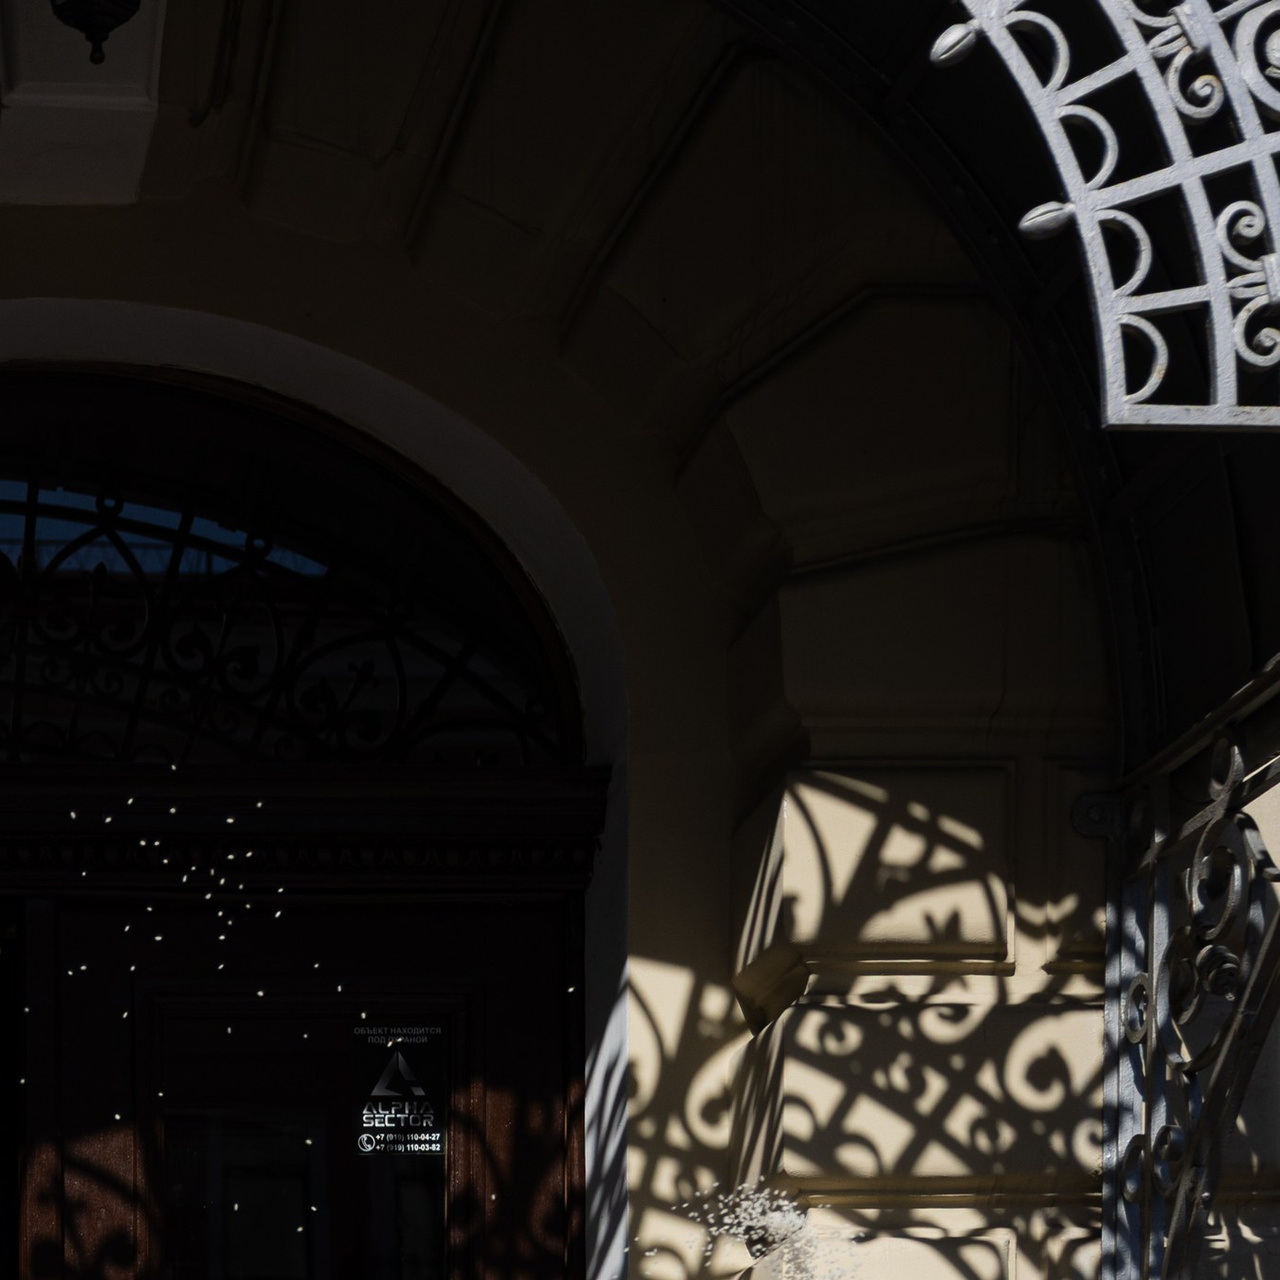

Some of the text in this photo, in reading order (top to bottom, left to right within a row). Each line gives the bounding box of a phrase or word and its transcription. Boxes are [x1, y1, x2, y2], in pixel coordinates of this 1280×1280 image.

[353, 1027, 442, 1035] ОБЪЕКТ НАХОДИТСЯ
[368, 1036, 386, 1044] ПОД
[362, 1101, 434, 1115] ALPHA
[362, 1114, 435, 1128] SECTOR
[375, 1133, 385, 1141] +7
[406, 1133, 441, 1141] 110-04-27
